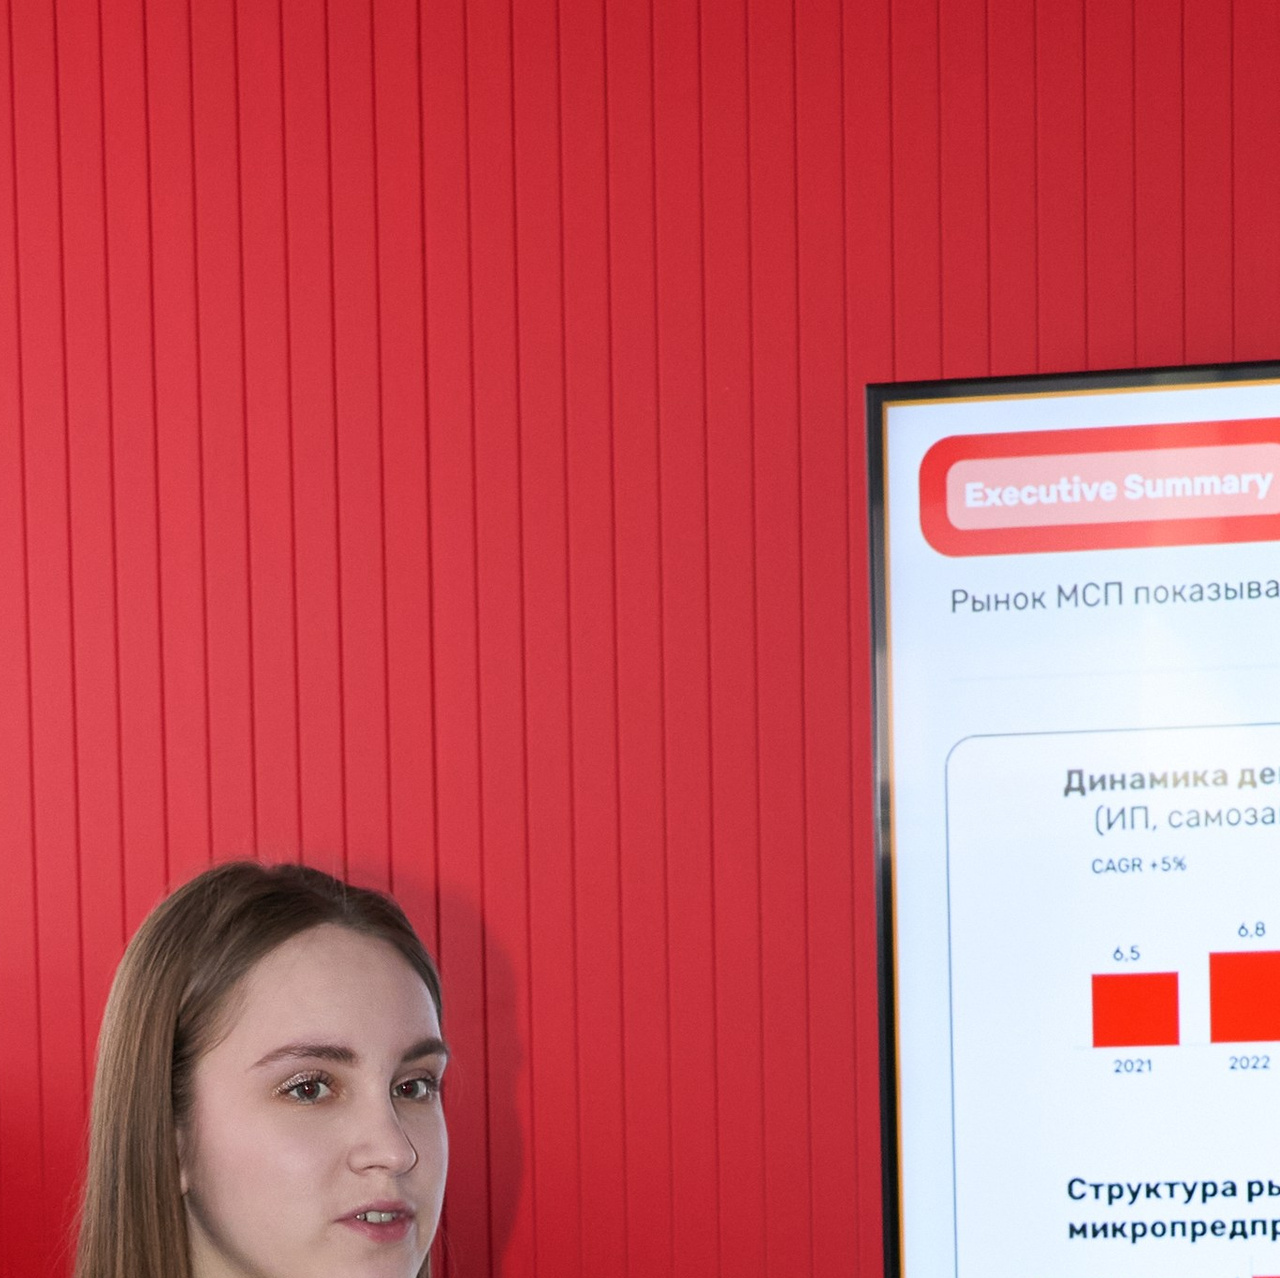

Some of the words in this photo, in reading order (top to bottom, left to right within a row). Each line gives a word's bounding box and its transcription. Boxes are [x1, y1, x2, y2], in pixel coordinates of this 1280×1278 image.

[965, 474, 1118, 507] Executive
[1124, 472, 1274, 500] Summary
[952, 589, 1046, 613] Рынок
[1057, 581, 1122, 608] МСП
[1135, 580, 1280, 604] показыва
[1064, 769, 1227, 797] Динамика
[1238, 767, 1280, 789] де
[1096, 805, 1156, 836] (ИП,
[1168, 807, 1280, 829] самоза
[1092, 858, 1142, 874] CAGR
[1151, 856, 1186, 872] +5%
[1114, 1059, 1151, 1073] 2021
[1230, 1055, 1270, 1070] 2022
[1068, 1178, 1237, 1205] Структура
